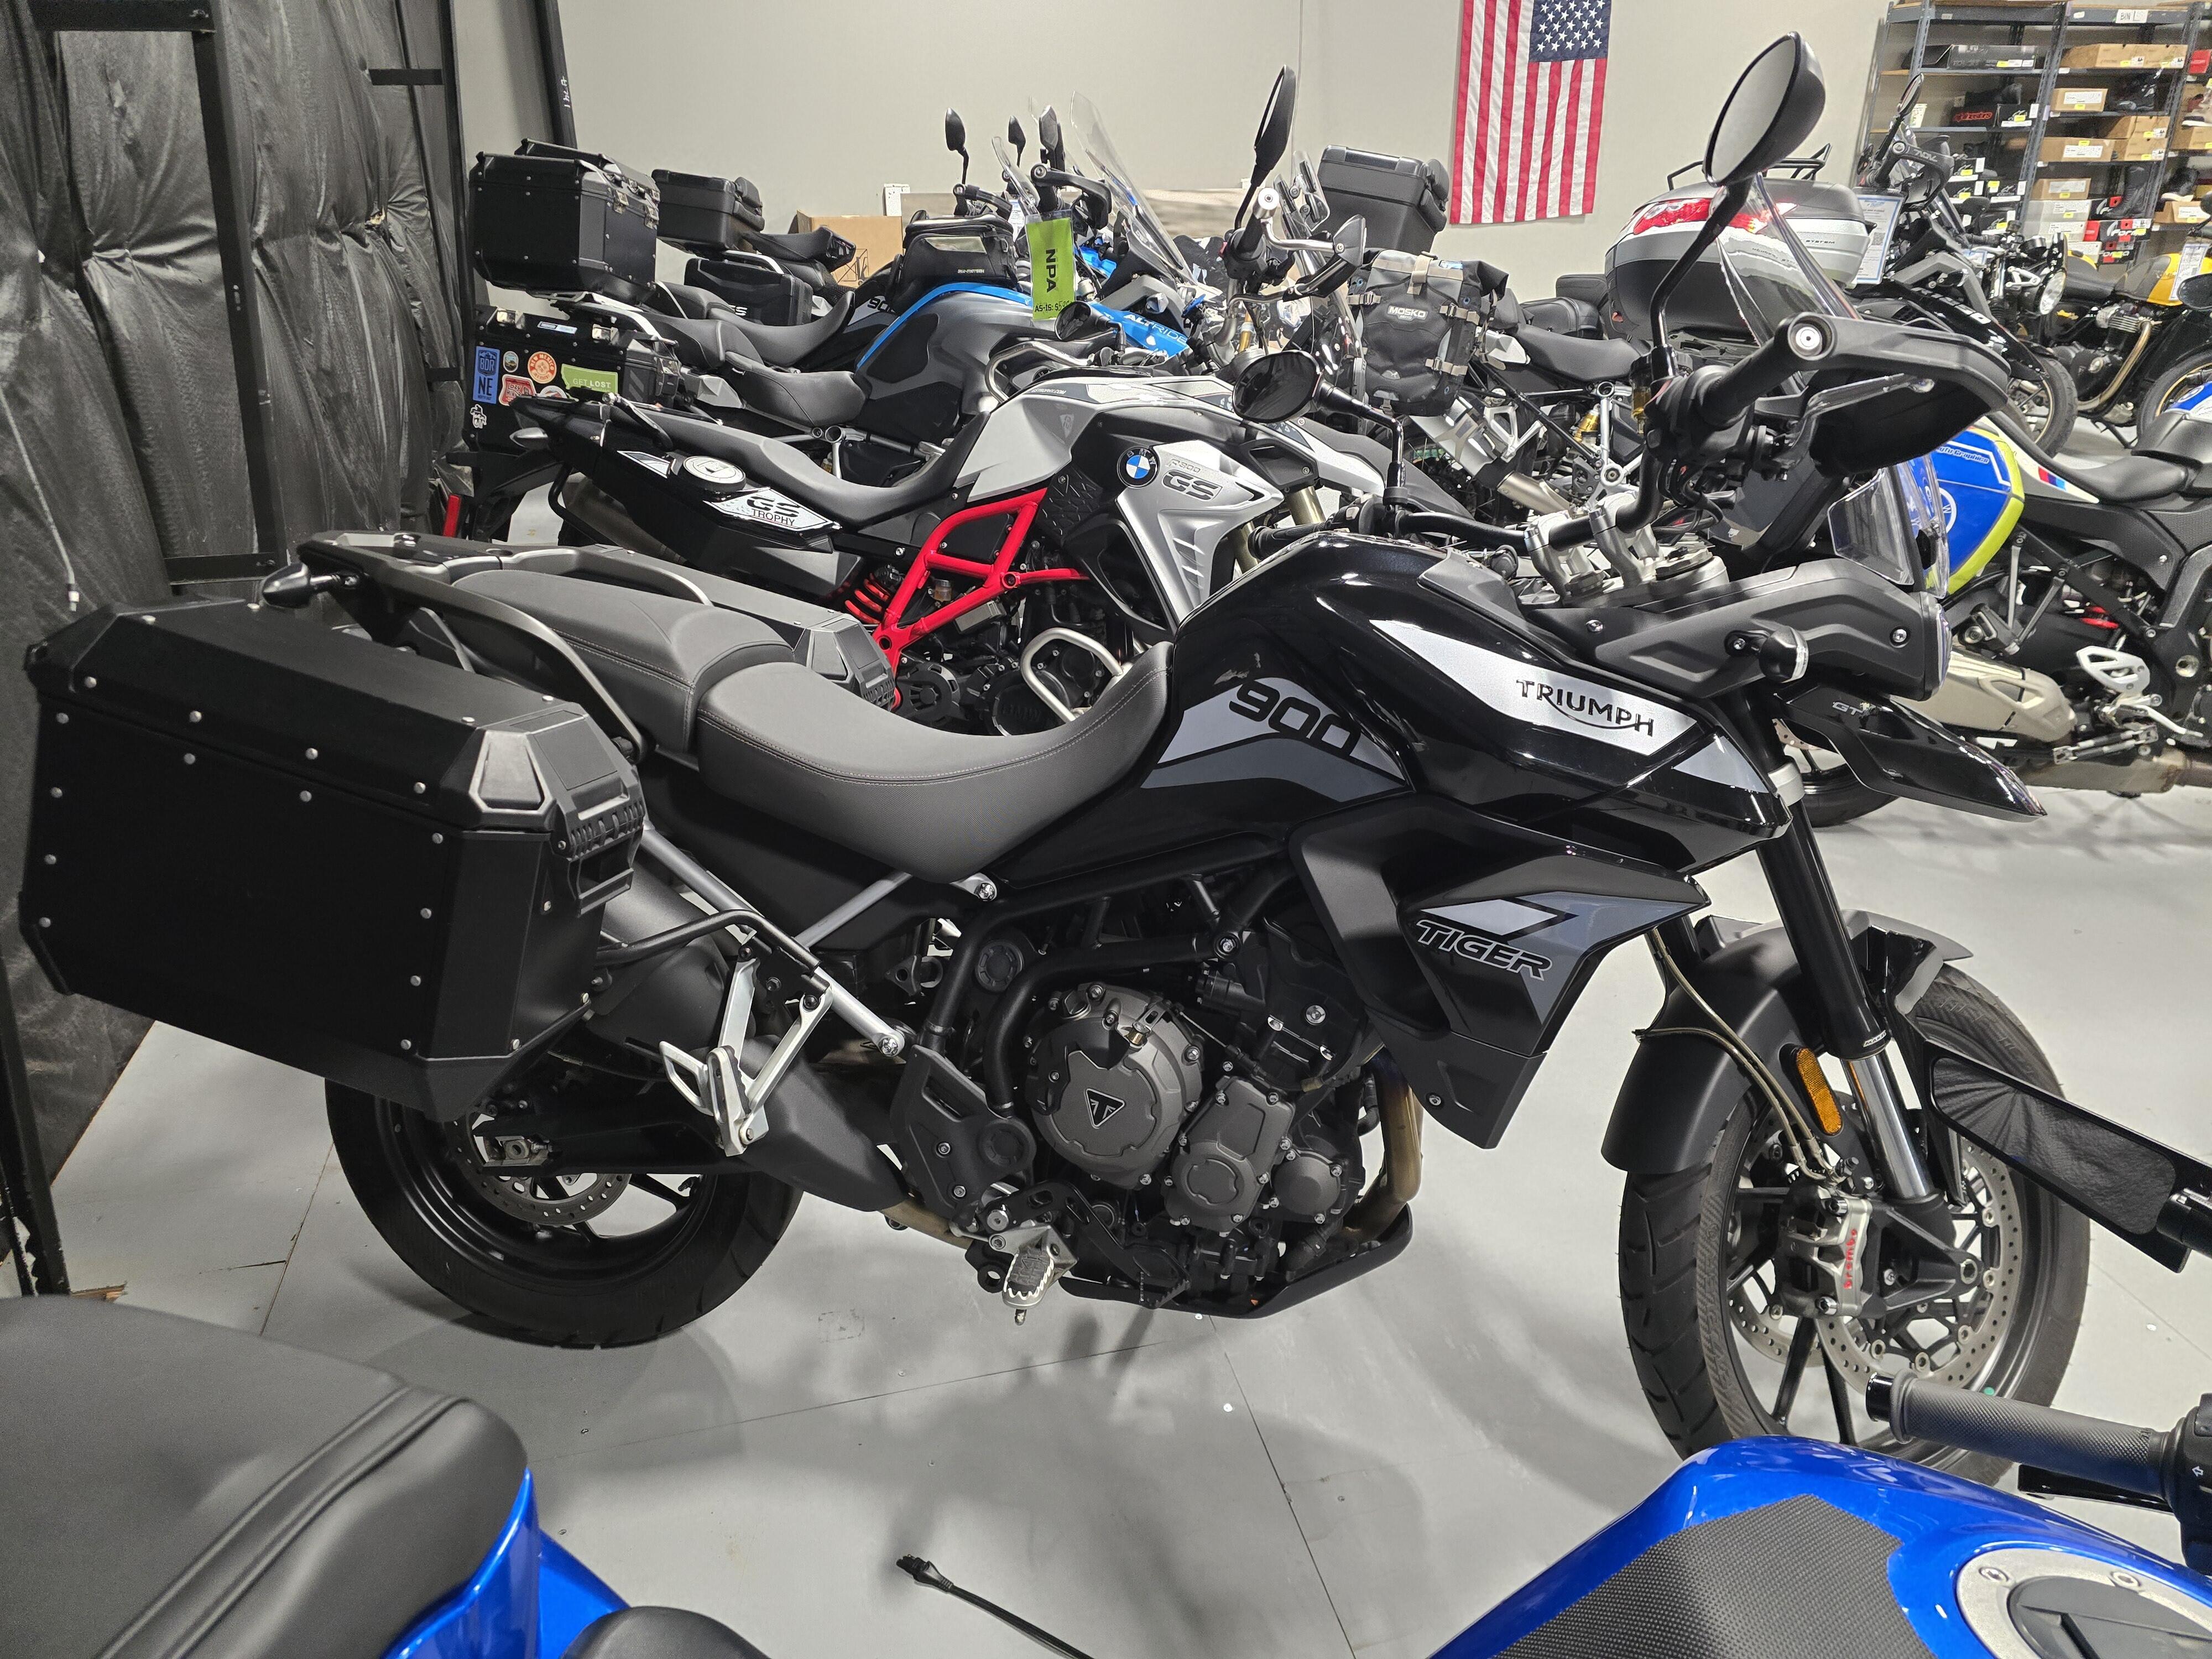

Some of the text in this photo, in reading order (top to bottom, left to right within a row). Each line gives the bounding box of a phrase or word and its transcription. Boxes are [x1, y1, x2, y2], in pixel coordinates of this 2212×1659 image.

[1046, 249, 1057, 293] NPA
[1389, 306, 1426, 318] MOSKO
[480, 358, 495, 372] BDR
[530, 353, 555, 371] NEW MEXICO
[478, 376, 493, 396] NE
[1126, 448, 1157, 465] BMW
[1954, 449, 1990, 464] Graphics
[1163, 471, 1219, 500] GS
[747, 496, 801, 518] GS
[752, 508, 795, 526] TROPHY
[1229, 680, 1361, 757] 900
[1516, 680, 1654, 737] TRIUMPH
[1416, 919, 1553, 981] TIGER
[1843, 1228, 1857, 1289] brembo
